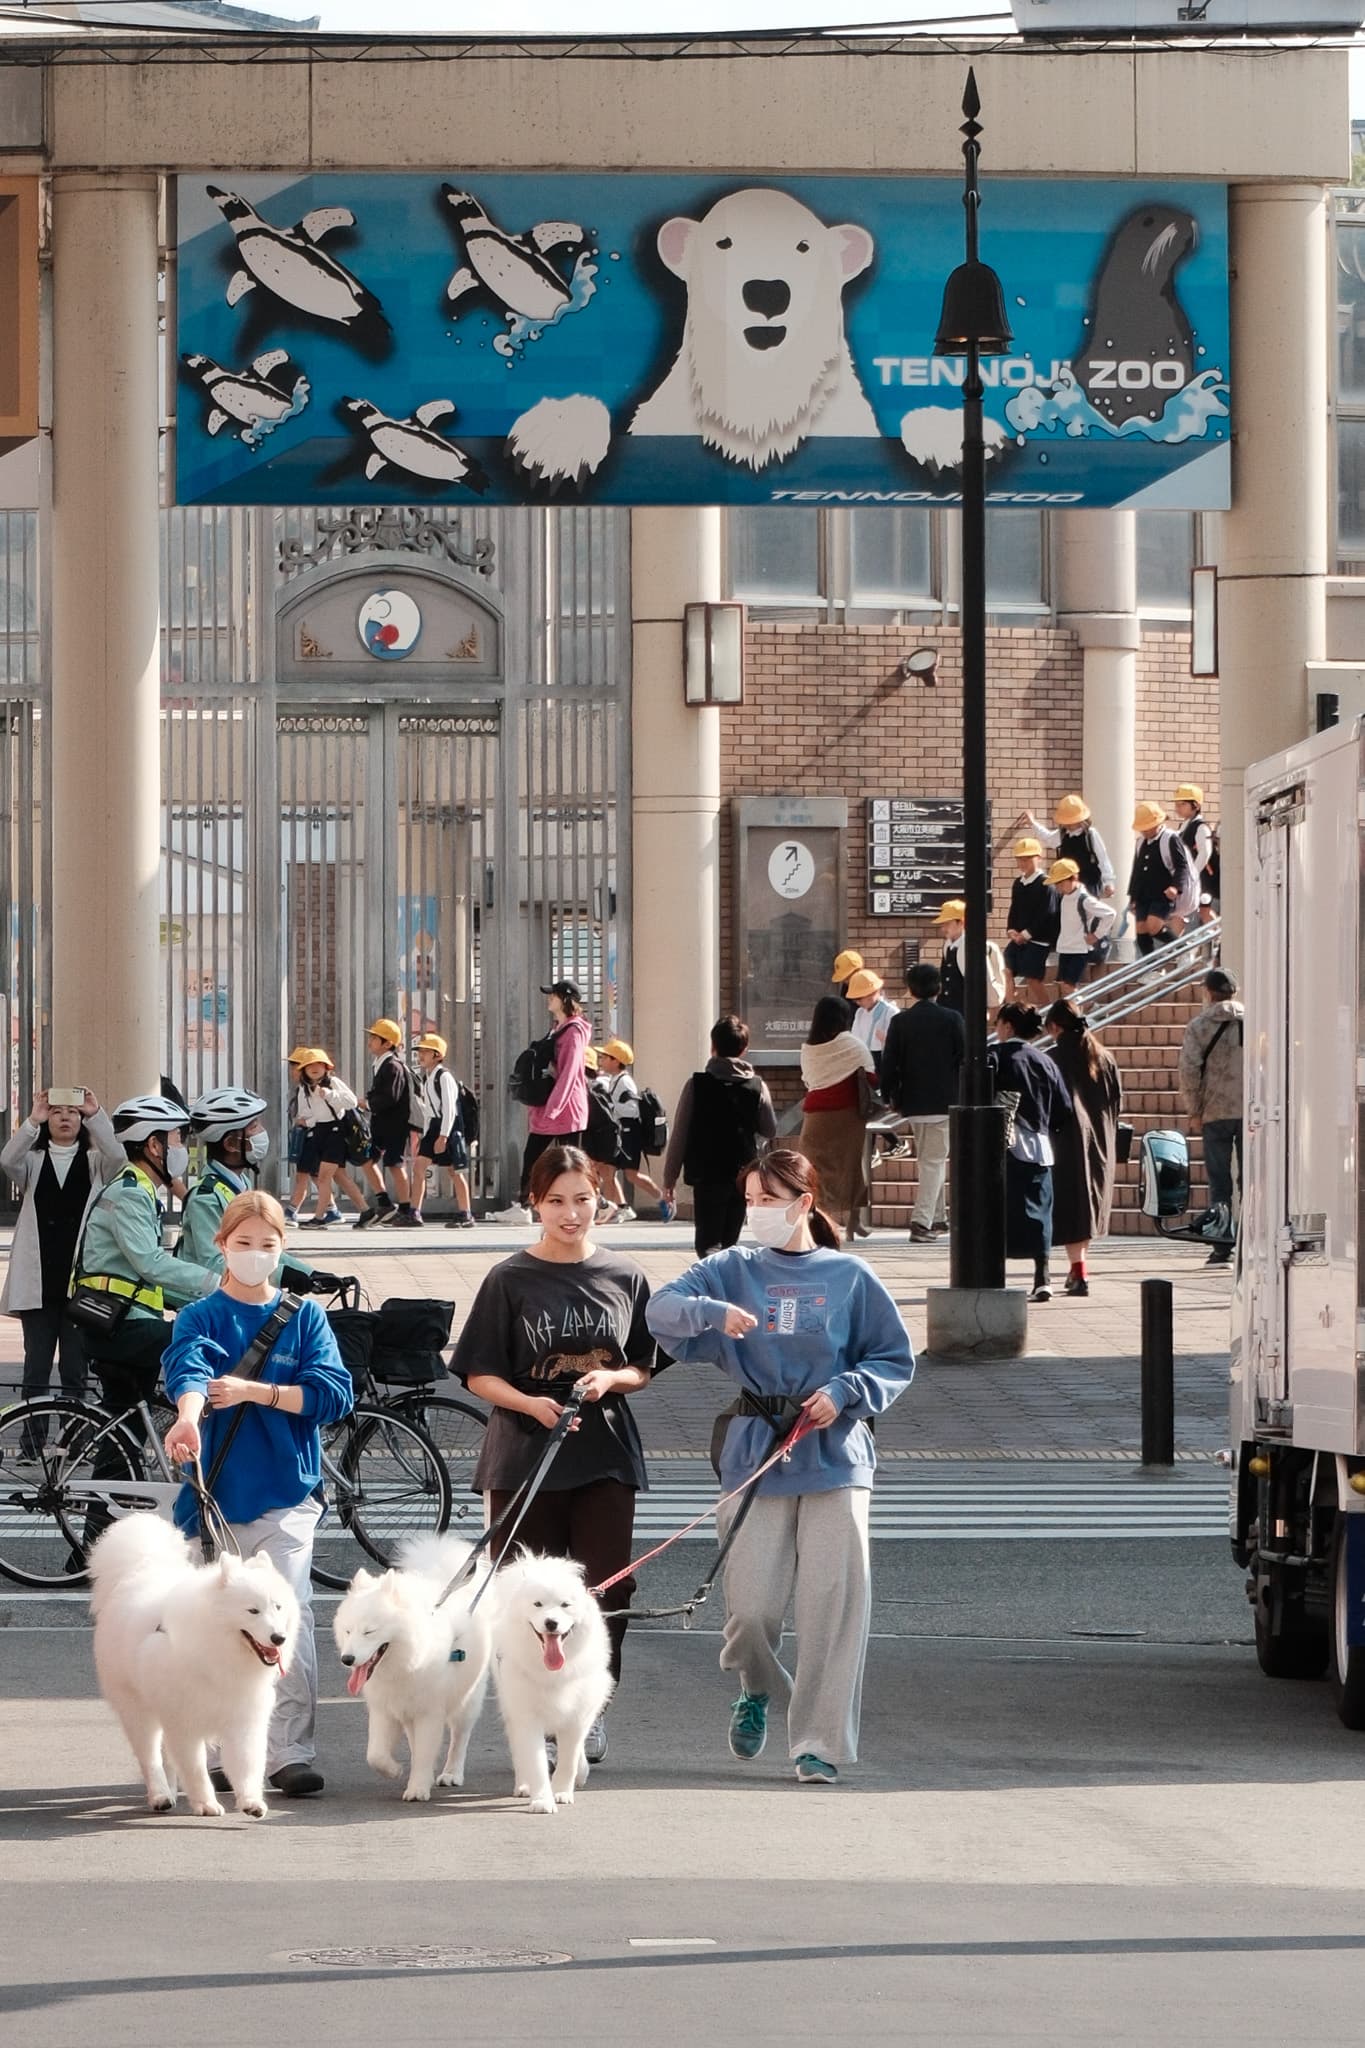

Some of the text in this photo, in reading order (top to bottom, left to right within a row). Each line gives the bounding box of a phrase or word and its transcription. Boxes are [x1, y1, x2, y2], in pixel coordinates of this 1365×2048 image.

[1088, 360, 1185, 389] ZOO
[984, 492, 1085, 502] ZOO
[522, 1308, 557, 1353] DEF
